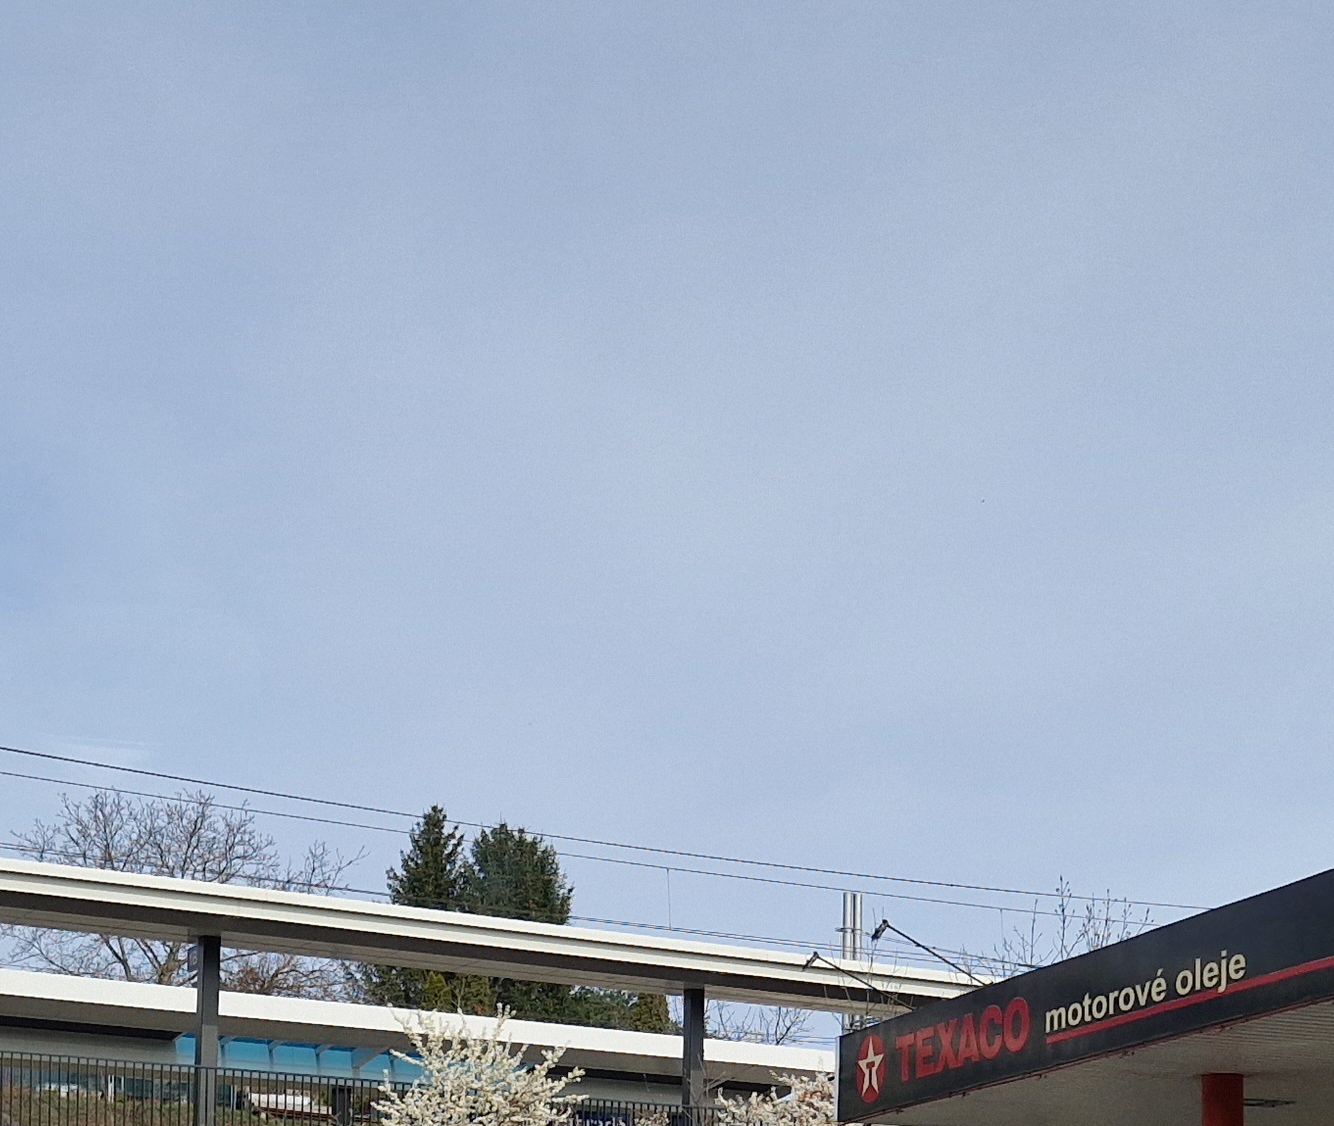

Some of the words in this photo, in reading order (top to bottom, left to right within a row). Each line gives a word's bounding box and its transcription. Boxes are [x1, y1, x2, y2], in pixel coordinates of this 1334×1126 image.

[895, 996, 1030, 1082] TEXACO
[1045, 968, 1167, 1034] motorové
[1174, 950, 1247, 994] oleje
